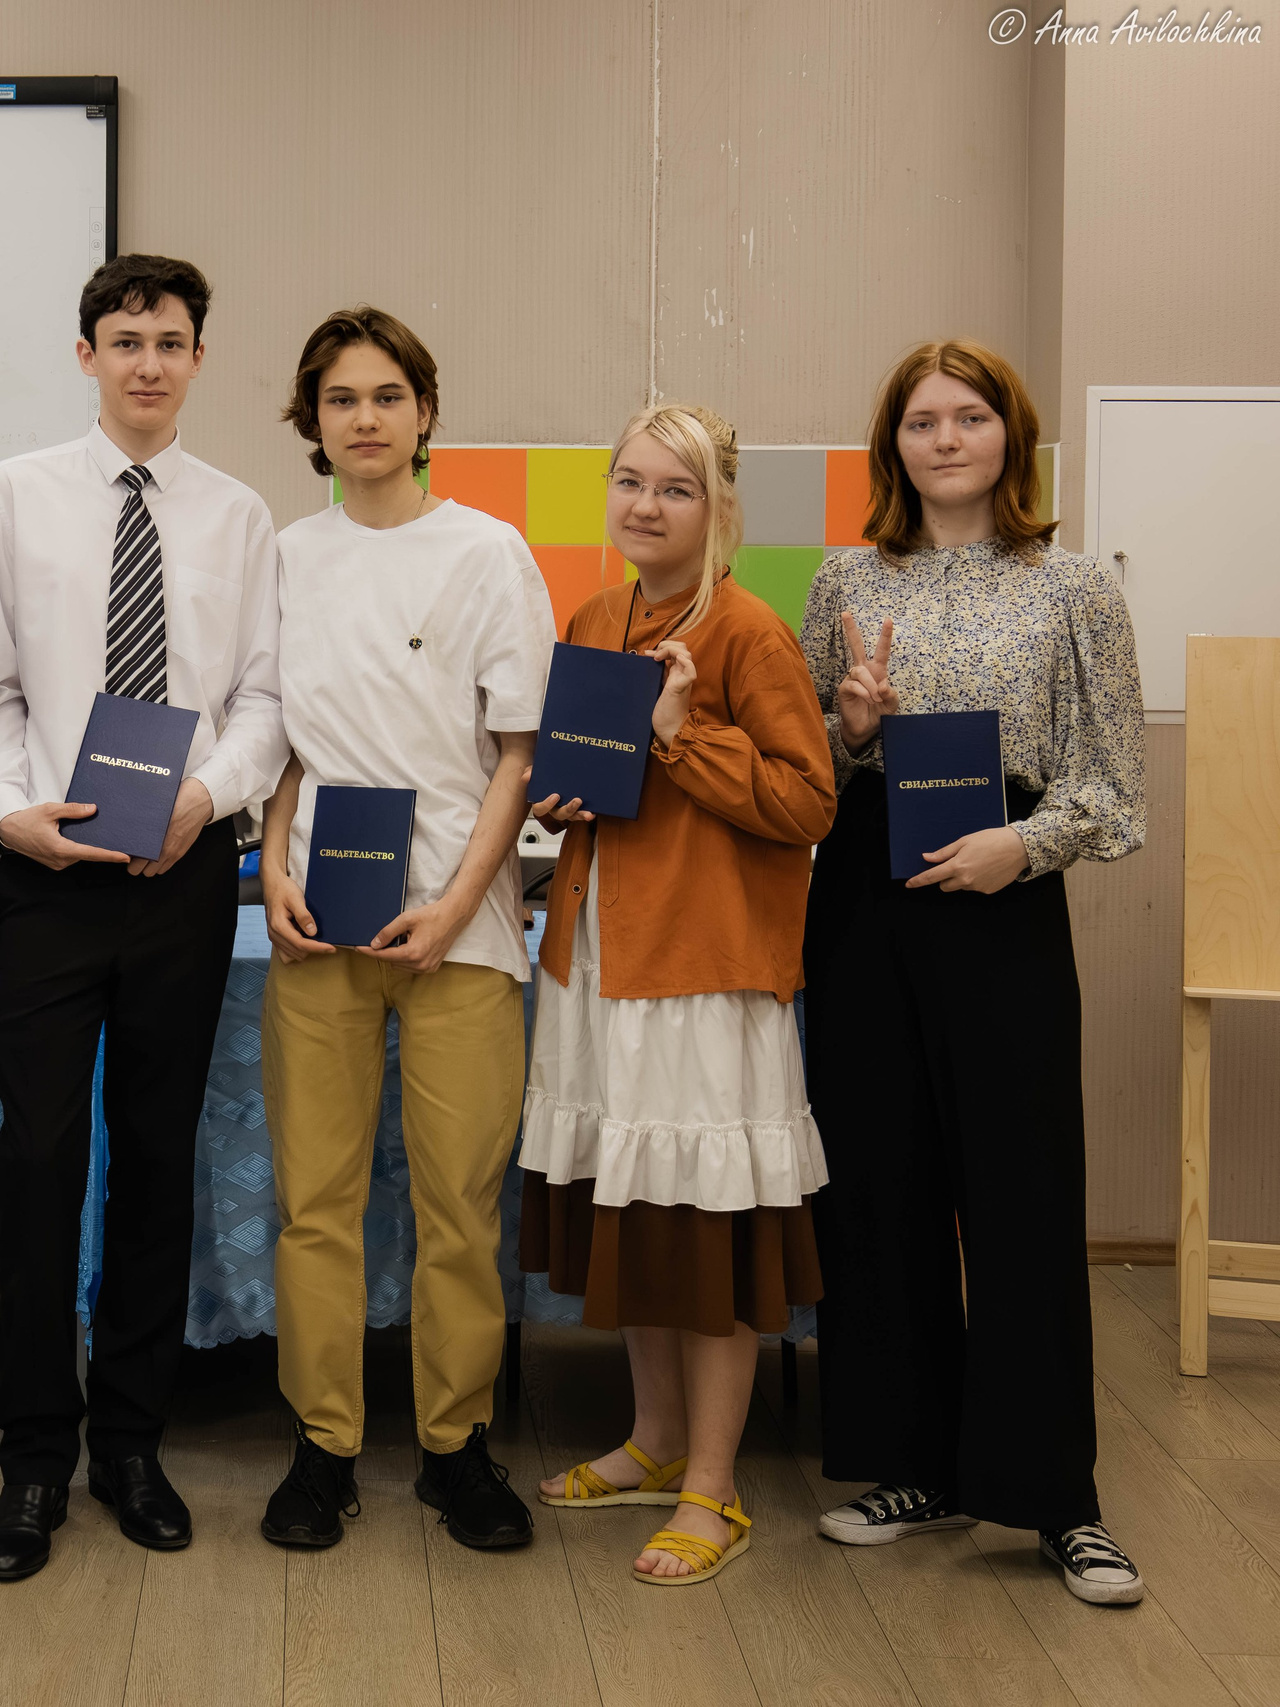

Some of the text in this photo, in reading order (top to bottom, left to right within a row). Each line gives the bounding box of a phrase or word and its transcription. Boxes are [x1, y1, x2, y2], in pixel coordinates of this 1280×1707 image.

[551, 730, 636, 753] СВИДЕТЕЛЬСТВО
[90, 753, 170, 776] СВИДЕТЕЛЬСТВО
[899, 777, 990, 790] СВИДЕТЕЛЬСТВО
[319, 848, 395, 861] СВИДЕТЕЛЬСТВО
